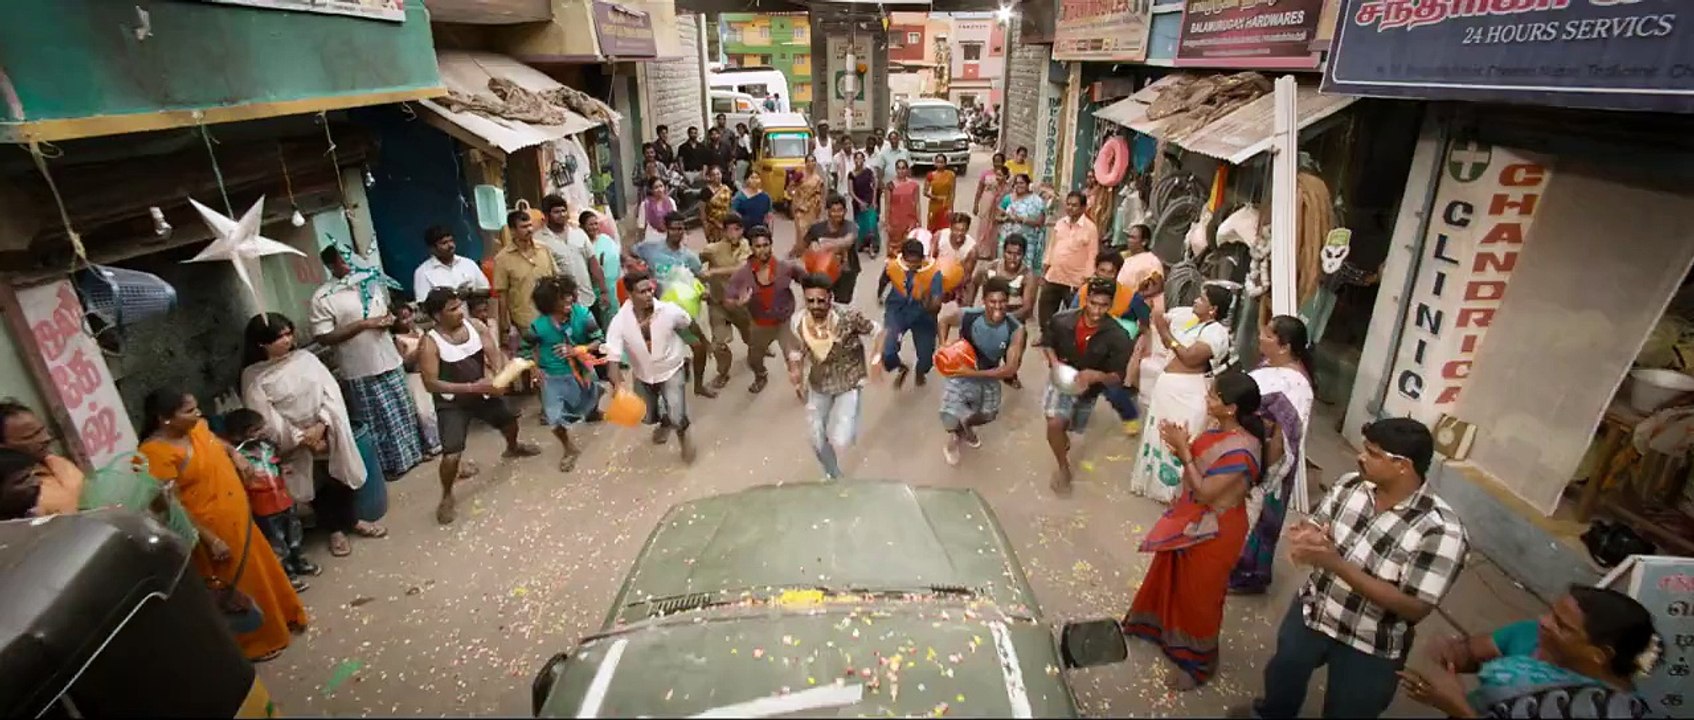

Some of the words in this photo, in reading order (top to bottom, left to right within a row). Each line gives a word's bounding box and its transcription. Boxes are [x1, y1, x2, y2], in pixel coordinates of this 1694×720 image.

[1462, 26, 1483, 44] 24
[1487, 21, 1558, 43] HOURS
[1562, 14, 1676, 40] SERVICS
[1397, 200, 1474, 399] CLINIC
[1435, 163, 1545, 405] CHANDRICA
